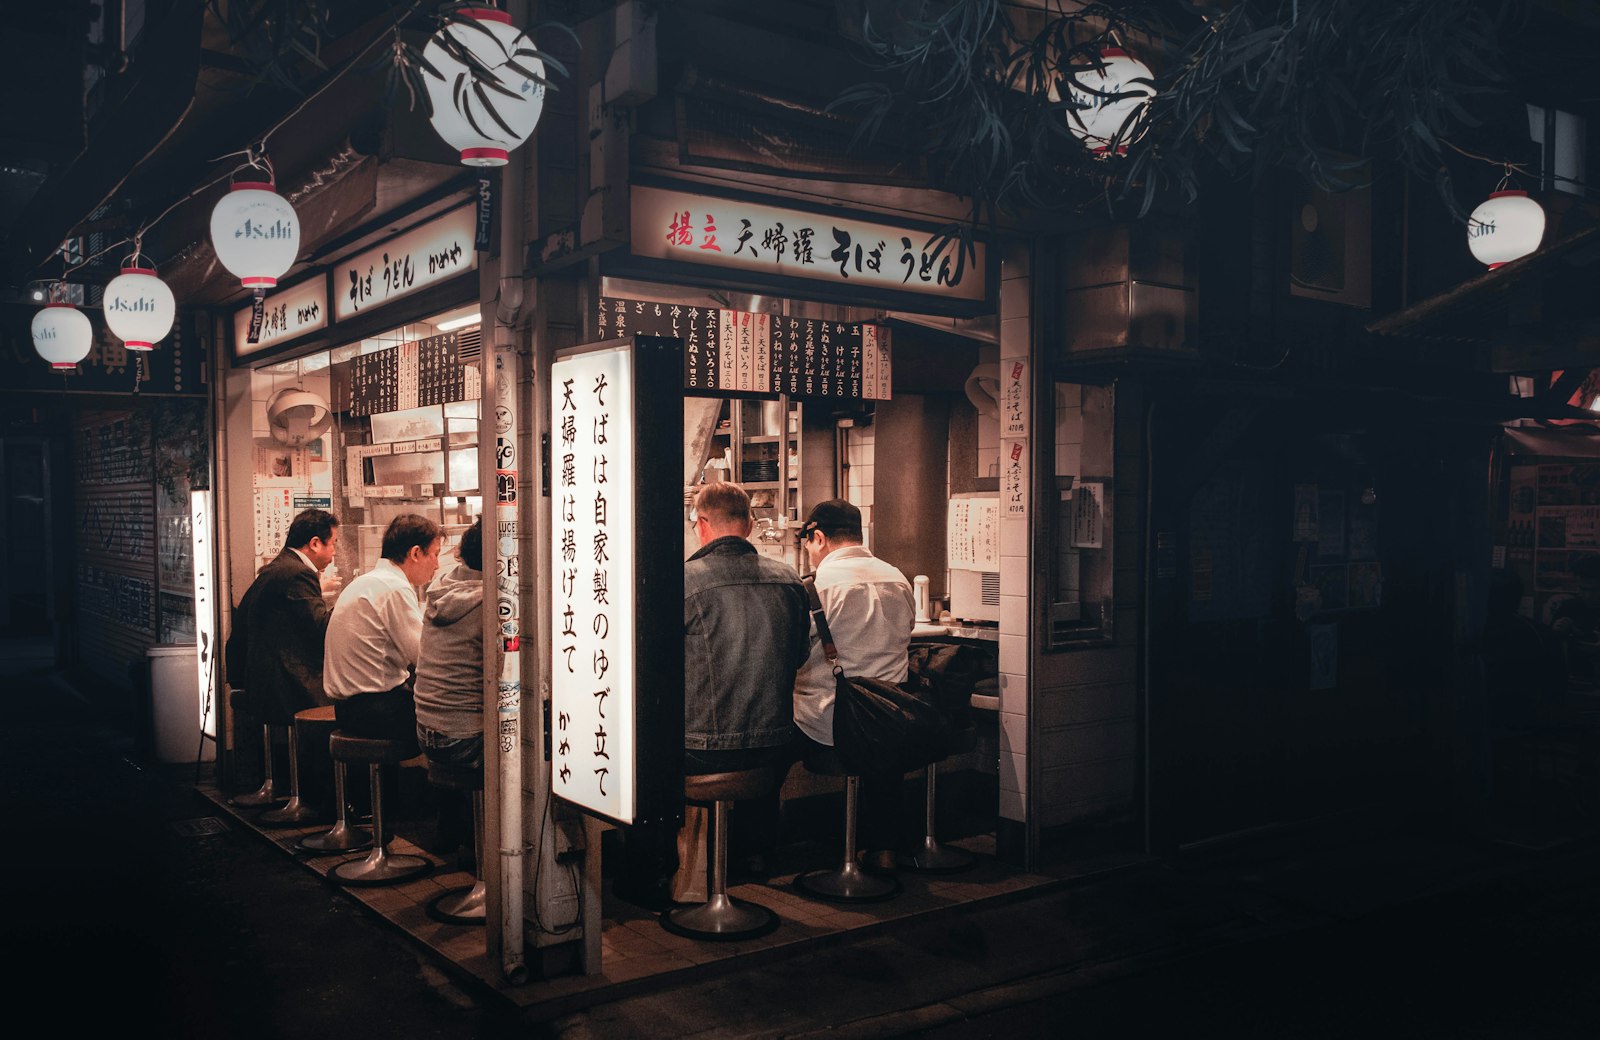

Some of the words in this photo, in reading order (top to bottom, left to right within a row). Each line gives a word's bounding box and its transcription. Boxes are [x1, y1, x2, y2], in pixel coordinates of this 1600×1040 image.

[235, 218, 291, 239] Asahi
[477, 179, 491, 244] アサヒビール
[350, 265, 373, 311] そば
[383, 253, 415, 299] うどん
[429, 241, 462, 274] かめや
[734, 219, 815, 264] 天婦羅
[832, 226, 885, 279] そば
[109, 296, 155, 312] Asahi
[562, 378, 577, 673] 天婦羅は揚げ立て
[593, 373, 610, 797] そばは自家製のゆで立て
[558, 710, 572, 785] かめや
